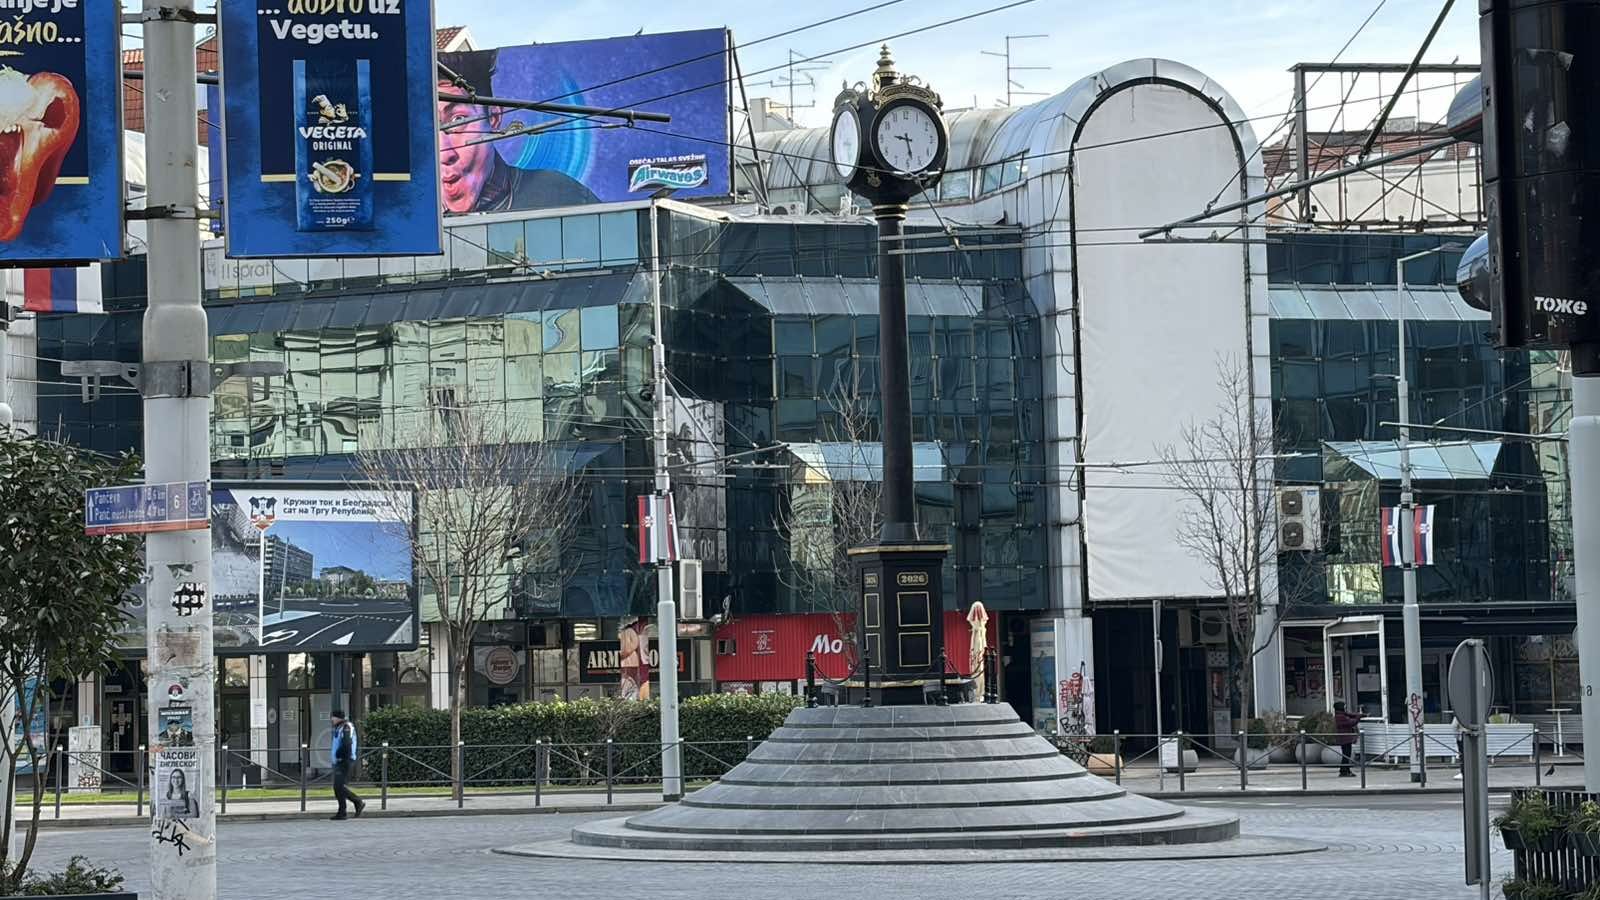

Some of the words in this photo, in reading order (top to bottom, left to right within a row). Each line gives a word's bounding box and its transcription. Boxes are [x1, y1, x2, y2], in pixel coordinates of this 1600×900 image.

[368, 0, 401, 14] uz
[270, 19, 379, 44] Vegetu.
[298, 126, 368, 140] VEGETA
[312, 141, 352, 151] ORIGINAL
[633, 165, 706, 184] Airwaves
[174, 495, 181, 508] 6
[283, 497, 317, 507] Кружни
[320, 499, 333, 507] ток
[311, 507, 329, 516] Тргу
[901, 575, 925, 583] 2026
[160, 751, 196, 761] ЧАСОВИ
